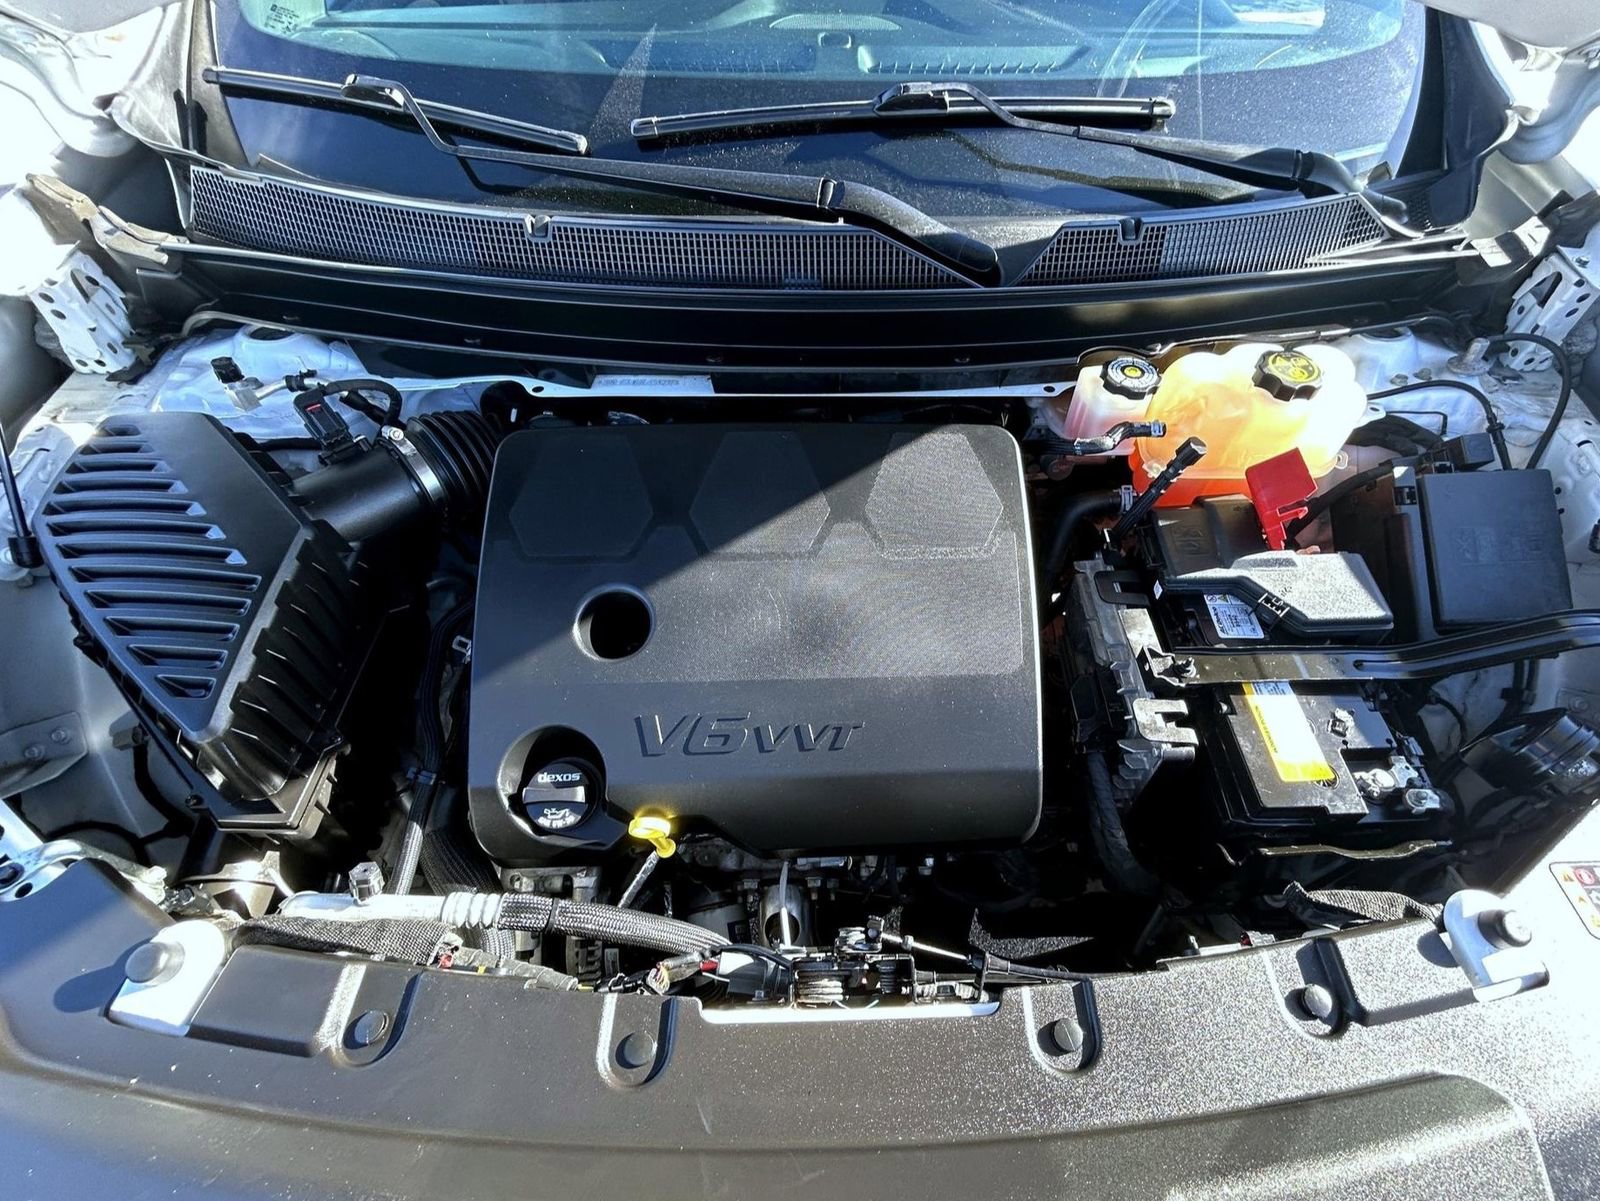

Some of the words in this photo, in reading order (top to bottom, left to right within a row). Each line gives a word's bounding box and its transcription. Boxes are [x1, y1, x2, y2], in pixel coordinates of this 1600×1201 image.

[634, 711, 752, 758] V6
[753, 721, 866, 754] VVT
[537, 772, 582, 783] dexos
